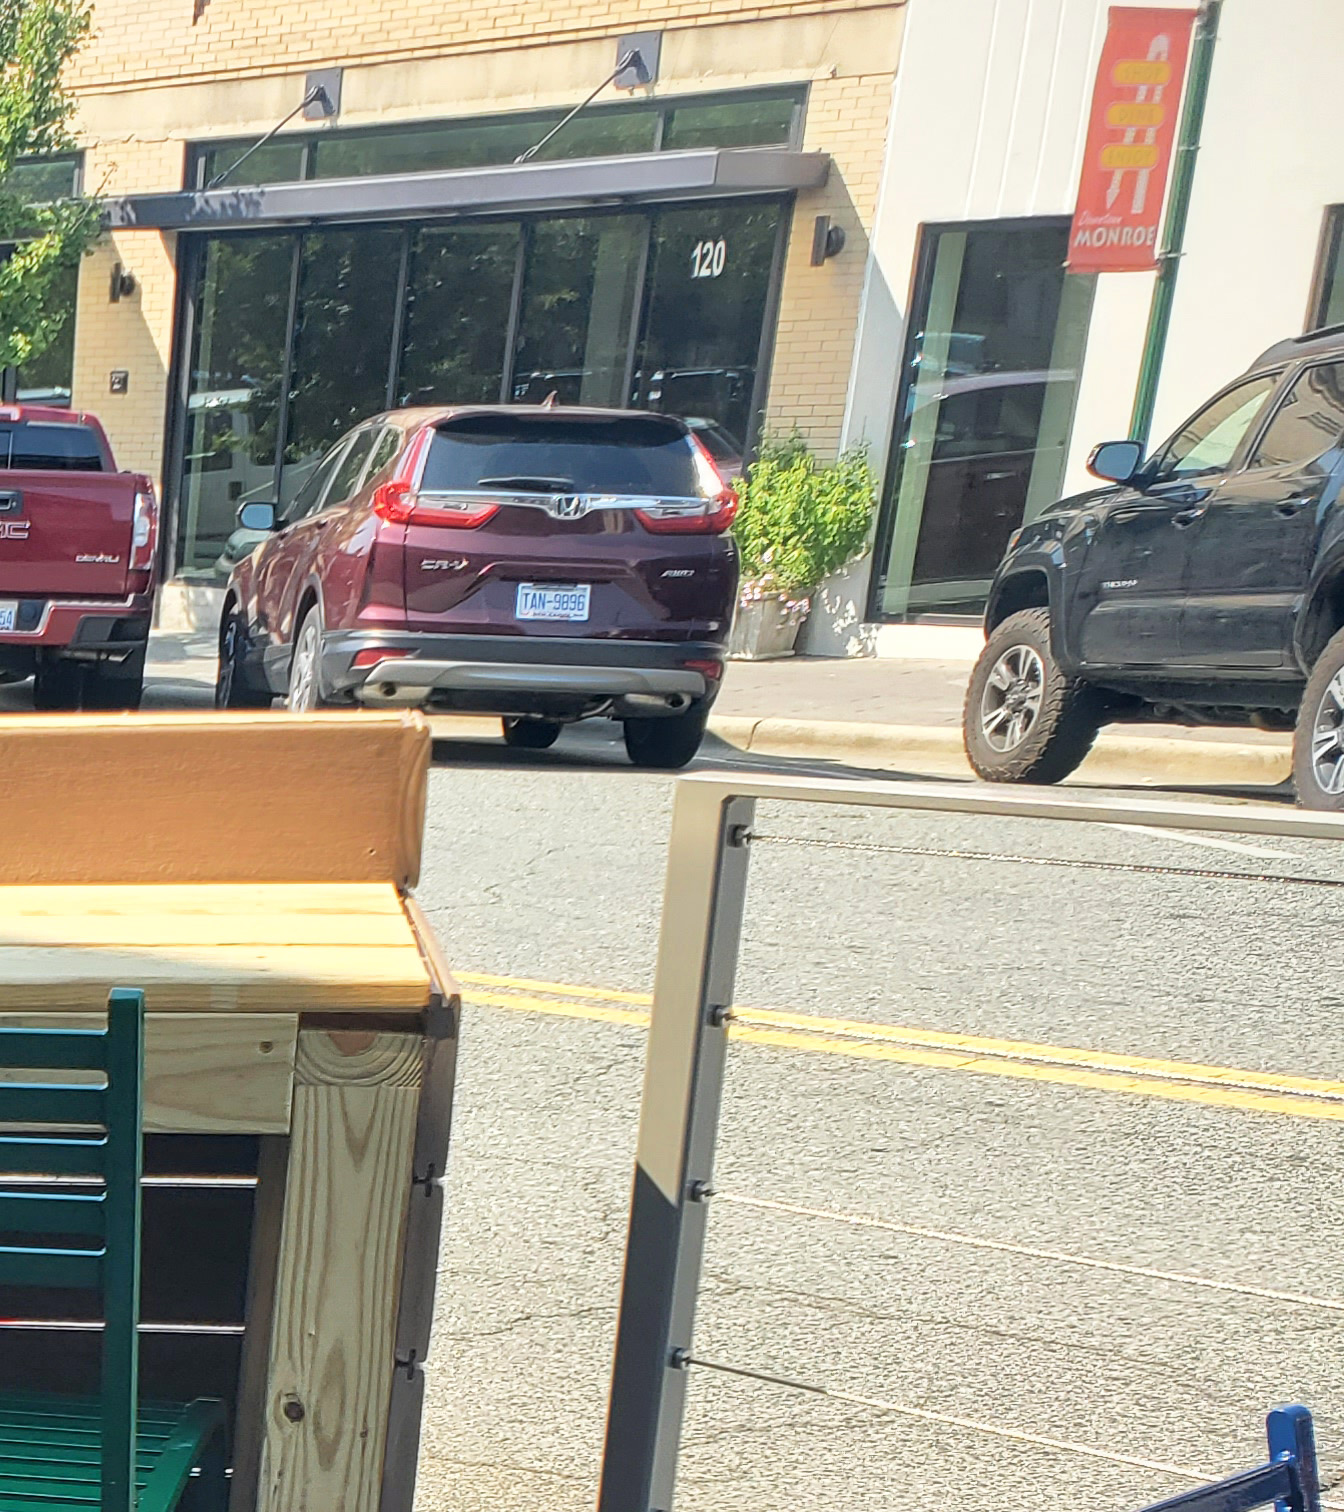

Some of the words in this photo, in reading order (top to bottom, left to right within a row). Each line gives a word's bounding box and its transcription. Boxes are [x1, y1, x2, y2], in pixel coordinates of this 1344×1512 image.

[1074, 225, 1156, 248] MONROE
[691, 240, 726, 278] 120
[522, 592, 586, 612] TAN-9896
